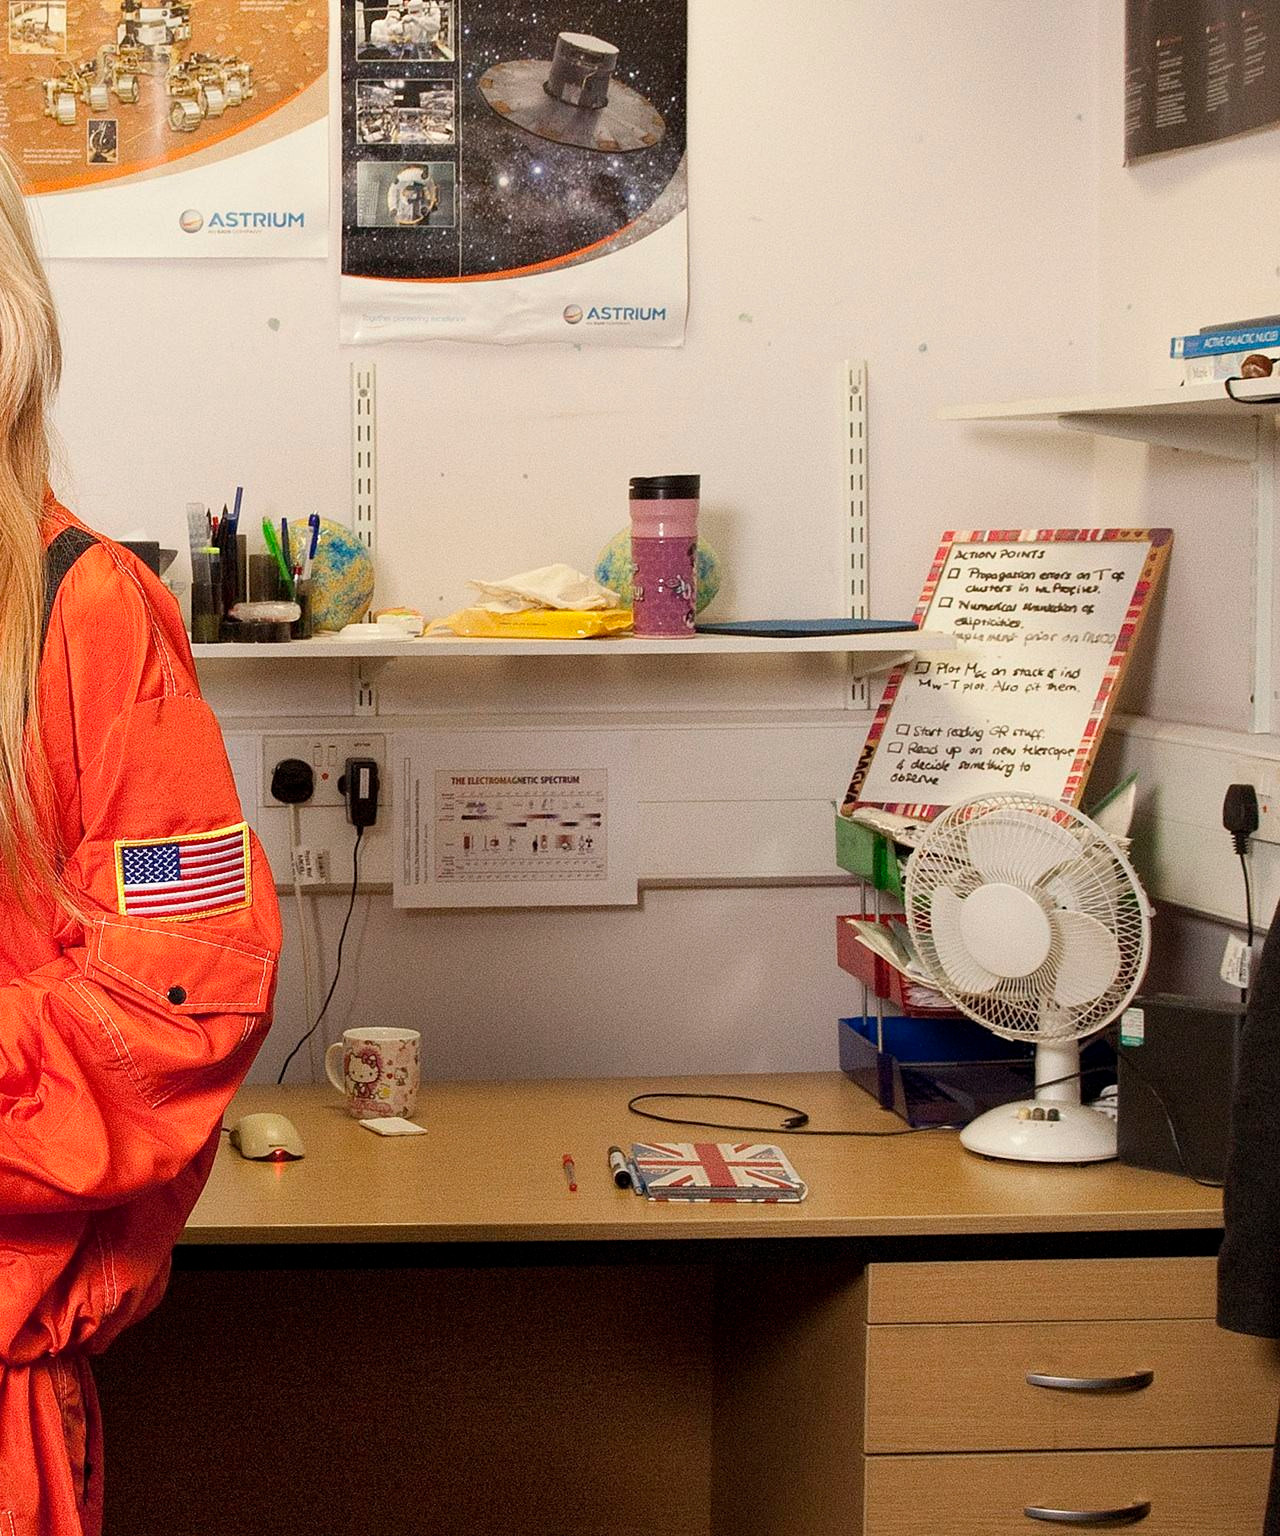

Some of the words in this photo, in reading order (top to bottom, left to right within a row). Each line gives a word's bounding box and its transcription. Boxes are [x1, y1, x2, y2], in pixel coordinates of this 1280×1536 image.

[208, 211, 304, 228] ASTRIUM
[586, 306, 667, 321] ASTRIUM
[954, 550, 997, 560] ACTION
[1000, 549, 1046, 559] POINTS
[1093, 568, 1112, 581] T
[1018, 583, 1029, 592] in
[936, 662, 961, 674] Plot
[913, 726, 942, 737] Start
[947, 726, 984, 742] reading
[908, 741, 938, 755] Read
[946, 746, 962, 759] up
[992, 746, 1016, 756] new
[1022, 744, 1076, 760] telescope
[910, 759, 950, 771] decide
[958, 759, 1015, 778] something
[1020, 762, 1031, 772] to
[451, 776, 466, 786] THE
[467, 775, 538, 786] ELECTROMAGNETIC
[540, 775, 580, 785] SPECTRUM
[890, 773, 939, 785] observe
